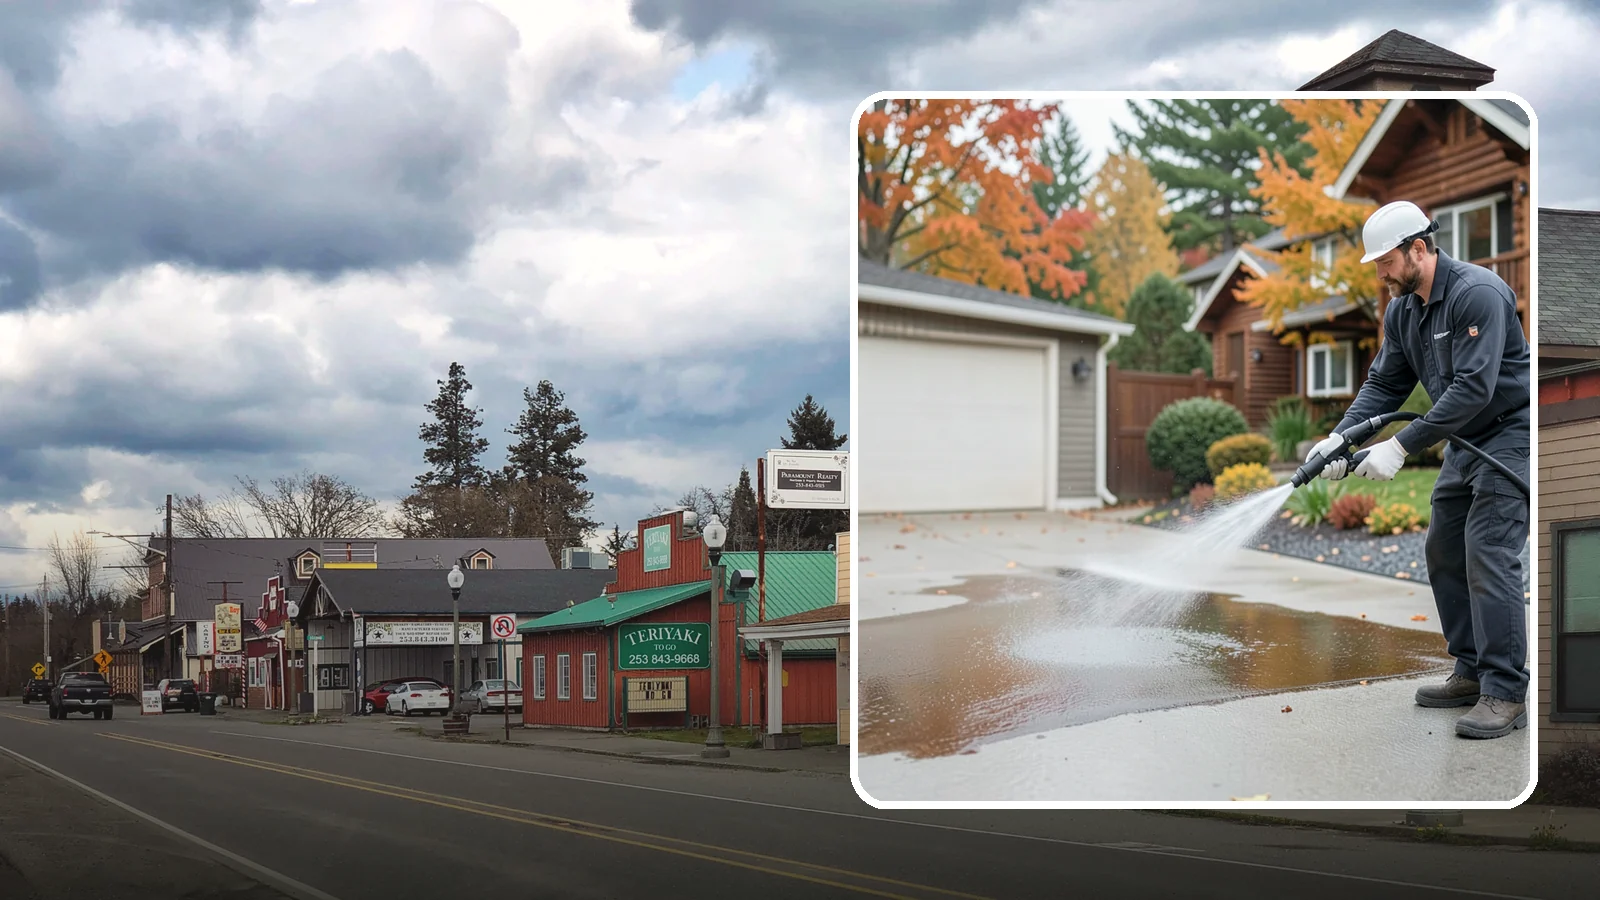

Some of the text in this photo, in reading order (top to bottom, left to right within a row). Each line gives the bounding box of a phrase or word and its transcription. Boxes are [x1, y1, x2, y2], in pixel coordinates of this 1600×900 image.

[781, 471, 839, 480] PARAMOUNT REALTY
[625, 627, 702, 646] TERIYAKI
[629, 653, 700, 664] 253 843-9668
